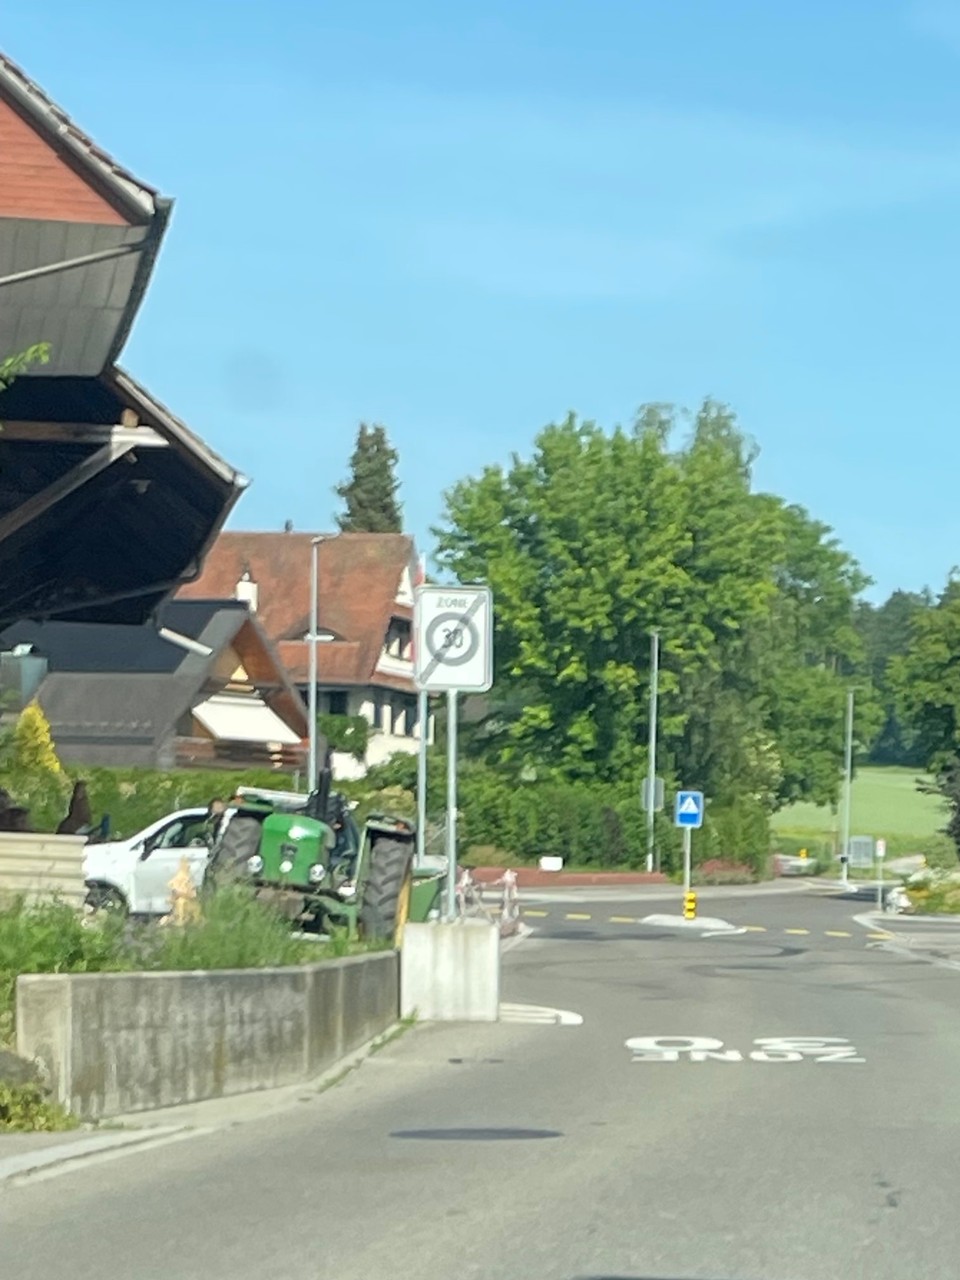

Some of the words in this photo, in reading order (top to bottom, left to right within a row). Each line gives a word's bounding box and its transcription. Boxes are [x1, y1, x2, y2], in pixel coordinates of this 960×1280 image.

[442, 628, 464, 648] 30
[624, 1036, 856, 1054] 30
[631, 1049, 867, 1062] ZONE
